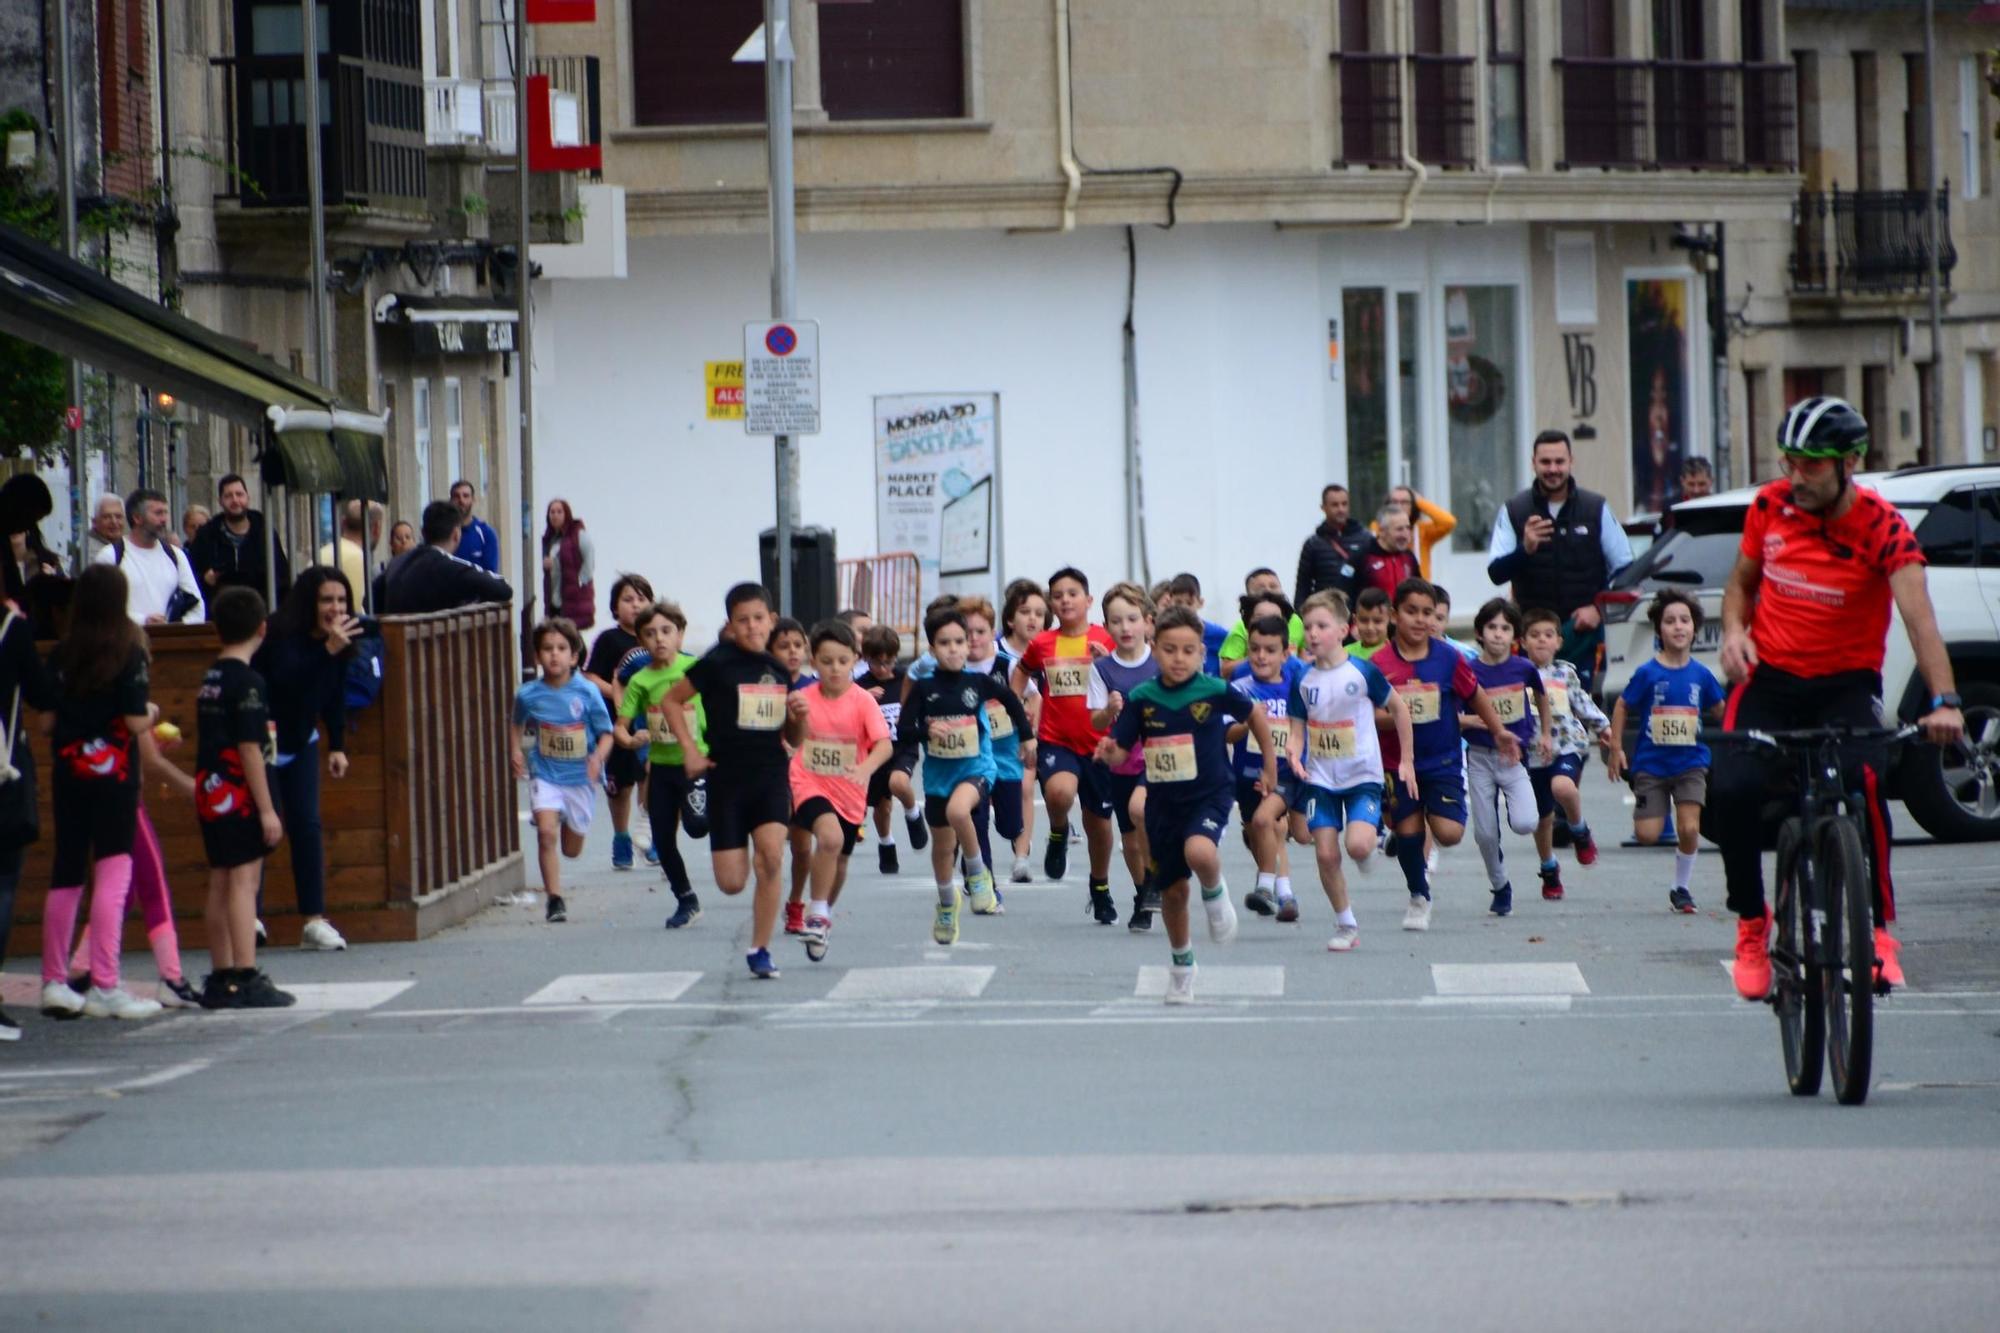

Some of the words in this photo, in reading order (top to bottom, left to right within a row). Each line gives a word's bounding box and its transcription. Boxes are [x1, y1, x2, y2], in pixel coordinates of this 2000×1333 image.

[888, 473, 937, 483] MARKET
[888, 485, 935, 497] PLACE
[1055, 671, 1081, 687] 433
[756, 700, 773, 718] 411
[1662, 720, 1688, 736] 554
[1318, 733, 1340, 750] 414
[811, 746, 841, 767] 556
[1155, 753, 1177, 772] 431
